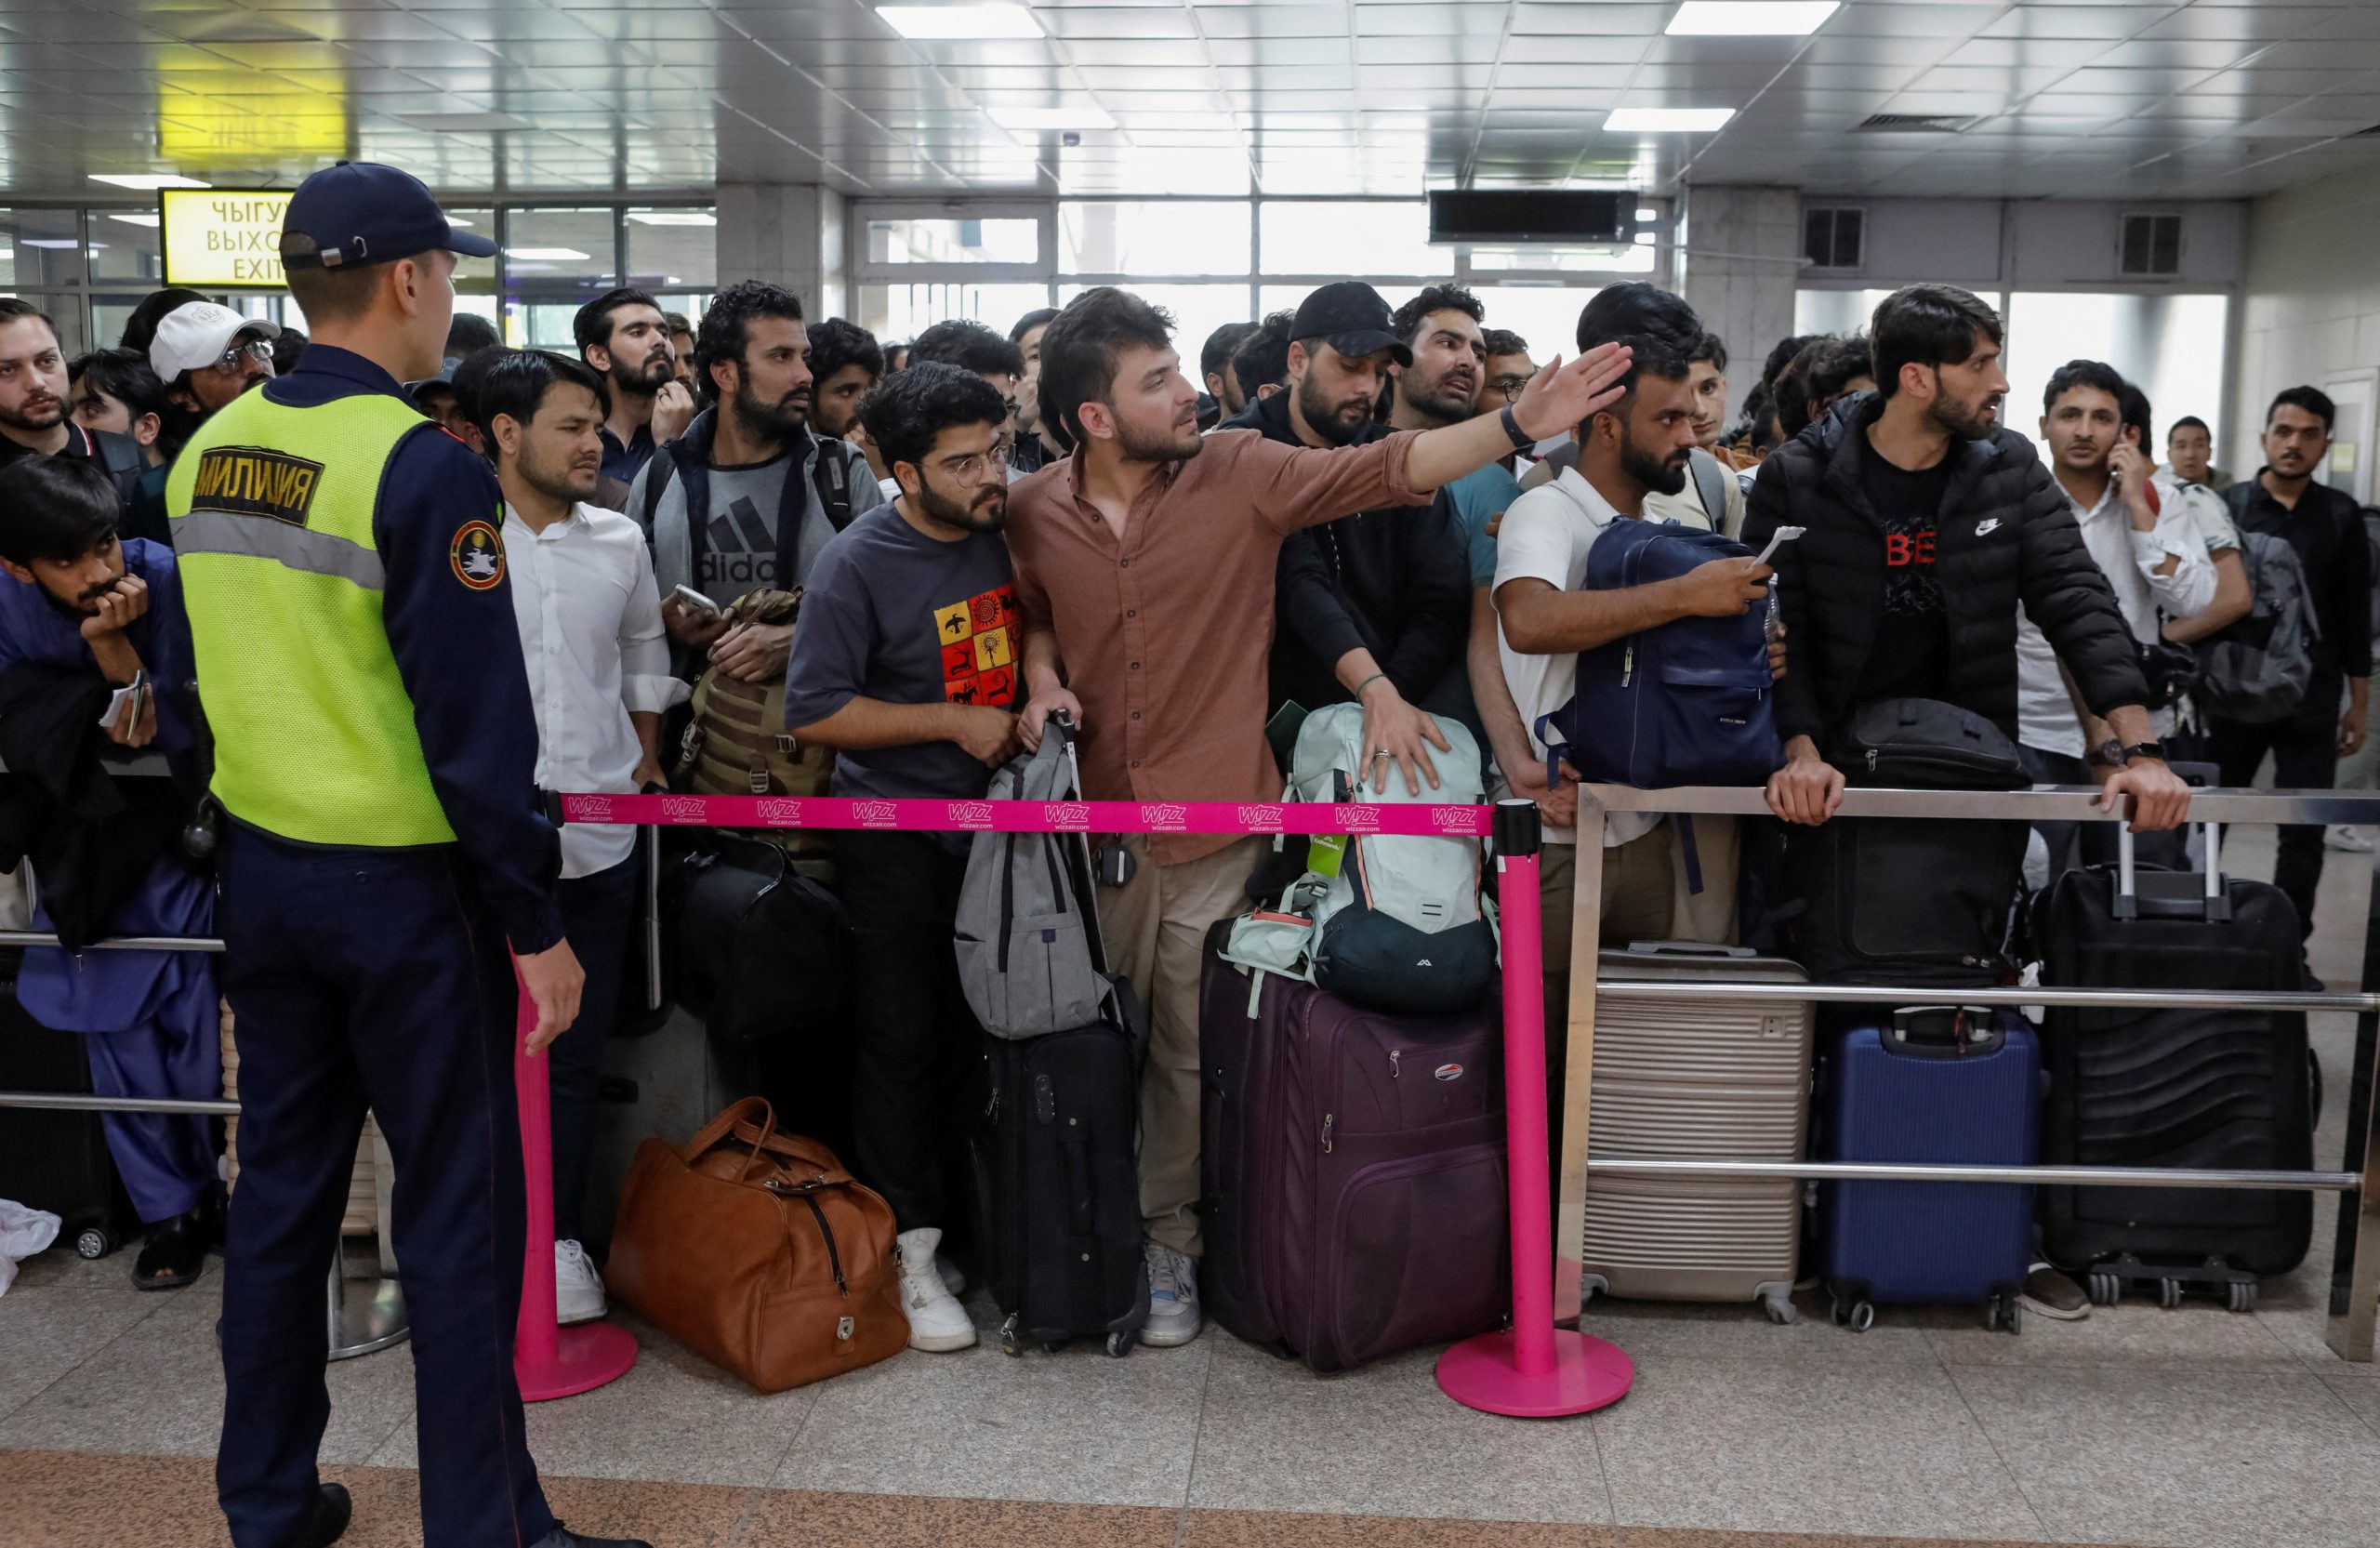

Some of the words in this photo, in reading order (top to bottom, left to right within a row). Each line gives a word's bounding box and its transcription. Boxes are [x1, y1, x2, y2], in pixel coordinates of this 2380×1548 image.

[212, 200, 289, 223] ЧЫГУ
[206, 229, 283, 252] ВЫХО
[233, 258, 283, 280] EXIT
[194, 456, 314, 511] МИЛИЦИЯ
[700, 553, 779, 583] dida
